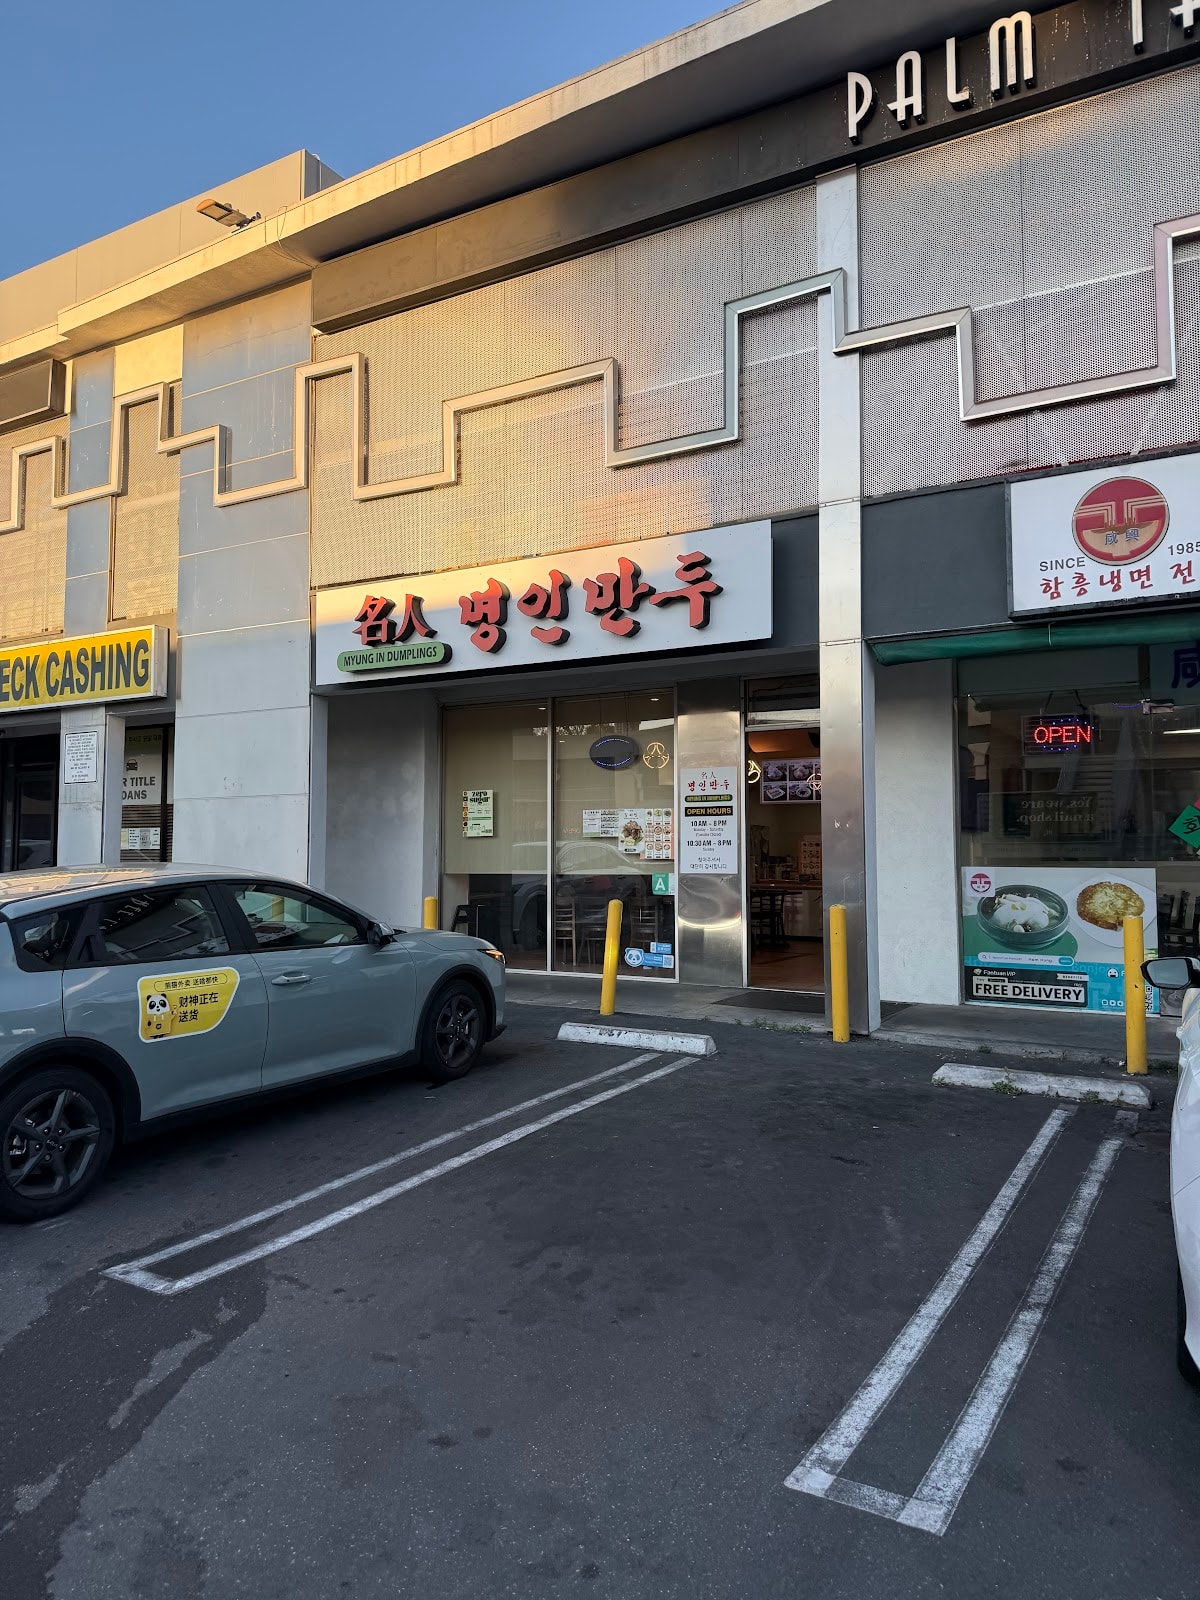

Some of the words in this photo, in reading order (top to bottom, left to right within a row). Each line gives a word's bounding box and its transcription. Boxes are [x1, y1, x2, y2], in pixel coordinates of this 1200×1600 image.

[847, 11, 1034, 144] PALM
[1039, 557, 1086, 571] SINCE
[1167, 541, 1200, 556] 1985
[1040, 565, 1153, 600] 함흥냉면
[459, 551, 724, 653] 명인만두
[354, 594, 438, 645] 名人
[343, 654, 374, 667] MYUNG
[376, 652, 385, 663] IN
[387, 646, 438, 662] DUMPLINGS
[46, 639, 149, 697] CASHING
[1033, 725, 1092, 743] OPEN
[130, 777, 156, 786] TITLE
[655, 878, 666, 890] A
[179, 992, 218, 1007] 财神正在
[976, 984, 1008, 995] FREE
[1013, 986, 1082, 1000] DELIVERY
[179, 1009, 198, 1023] 送货
